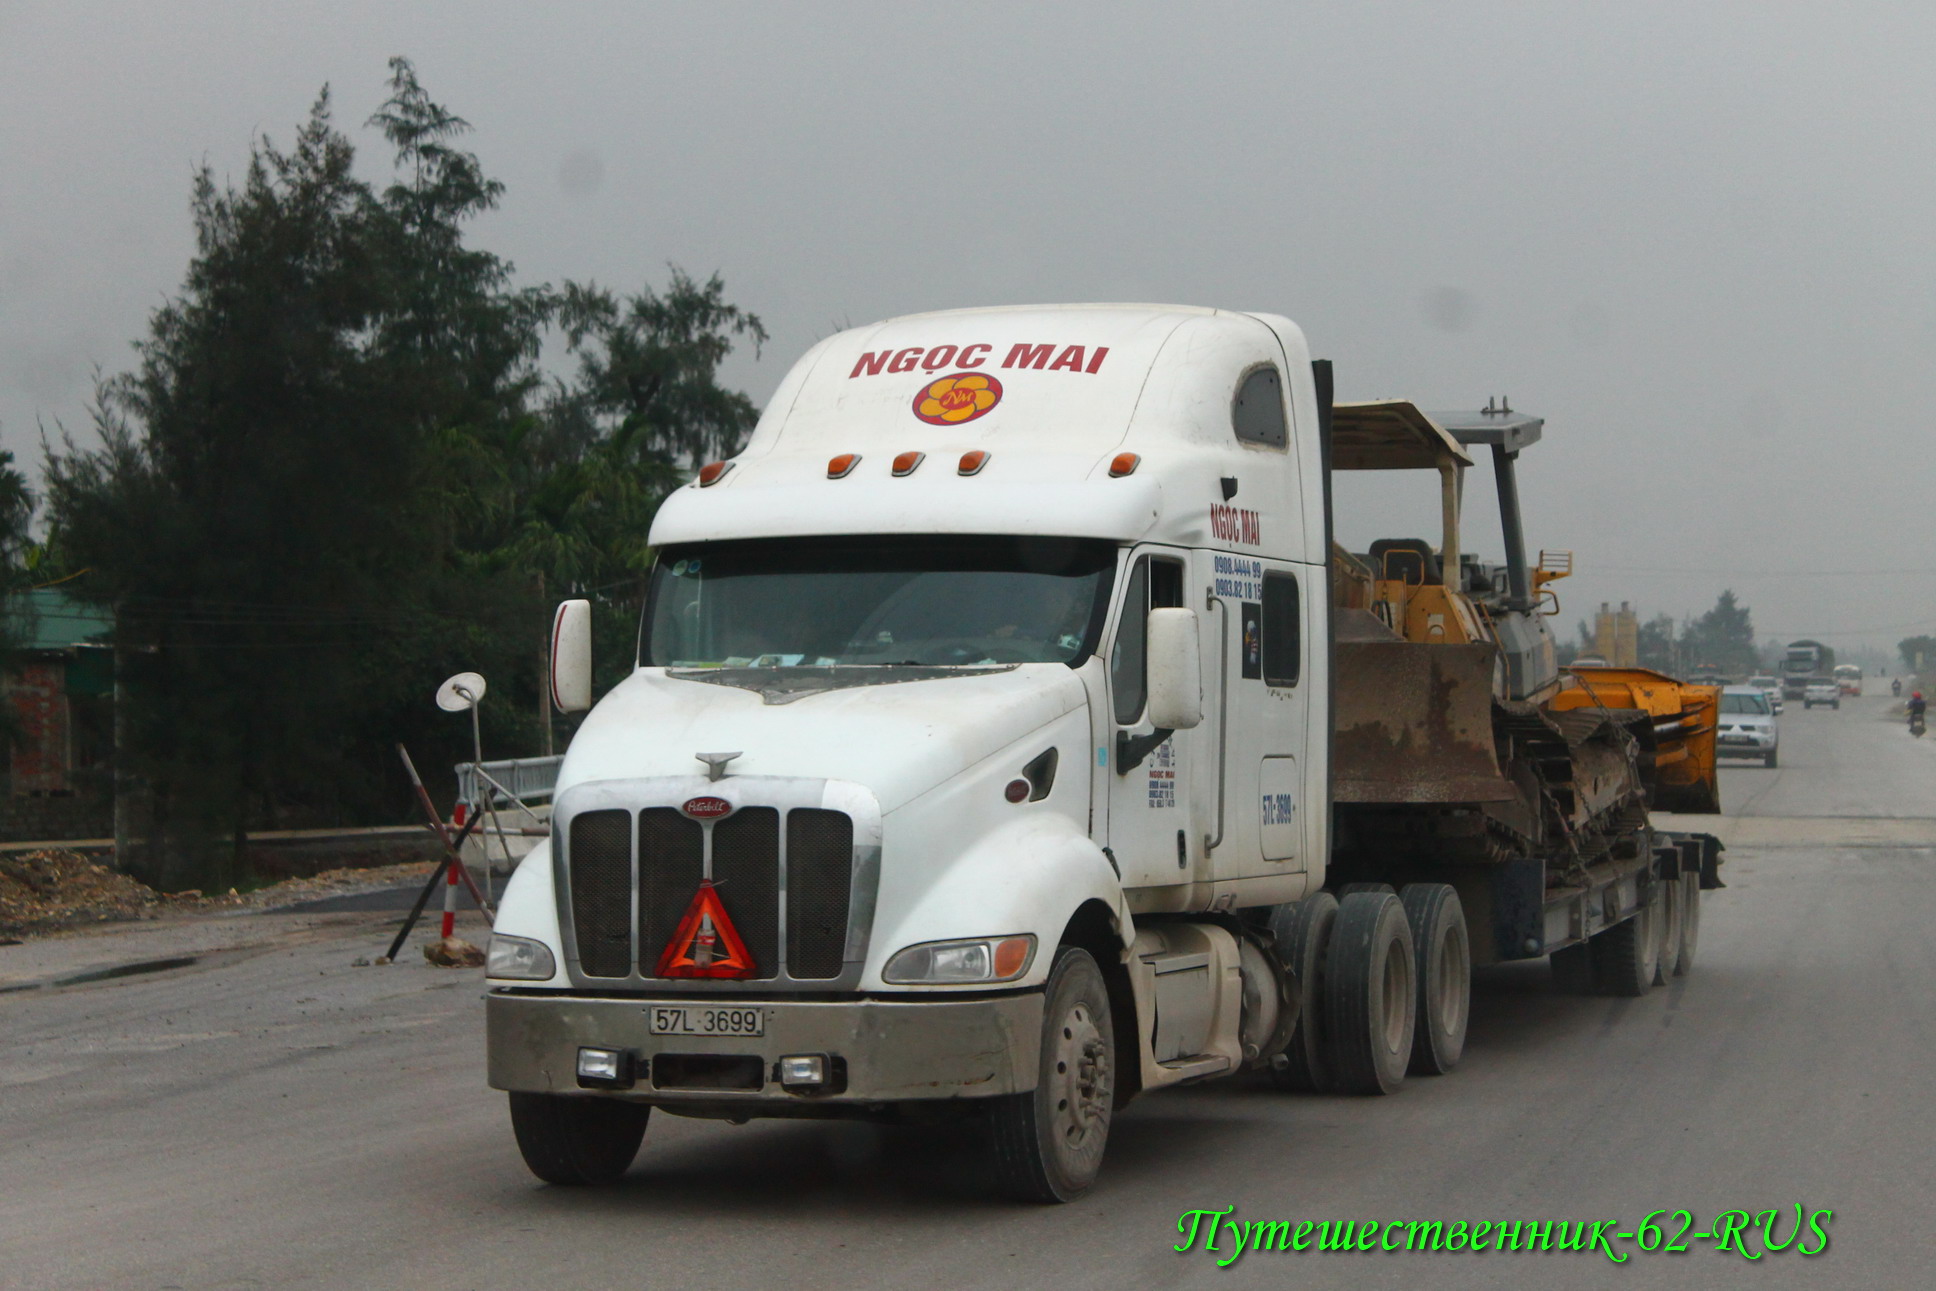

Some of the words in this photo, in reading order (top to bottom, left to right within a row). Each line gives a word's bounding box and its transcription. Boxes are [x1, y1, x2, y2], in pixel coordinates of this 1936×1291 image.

[849, 344, 993, 379] NGỌC
[1000, 343, 1110, 375] MAI
[1210, 502, 1240, 549] NGỌC
[1240, 509, 1260, 547] MAI
[1252, 561, 1262, 579] 99
[1244, 582, 1253, 600] 18
[1254, 583, 1263, 601] 15
